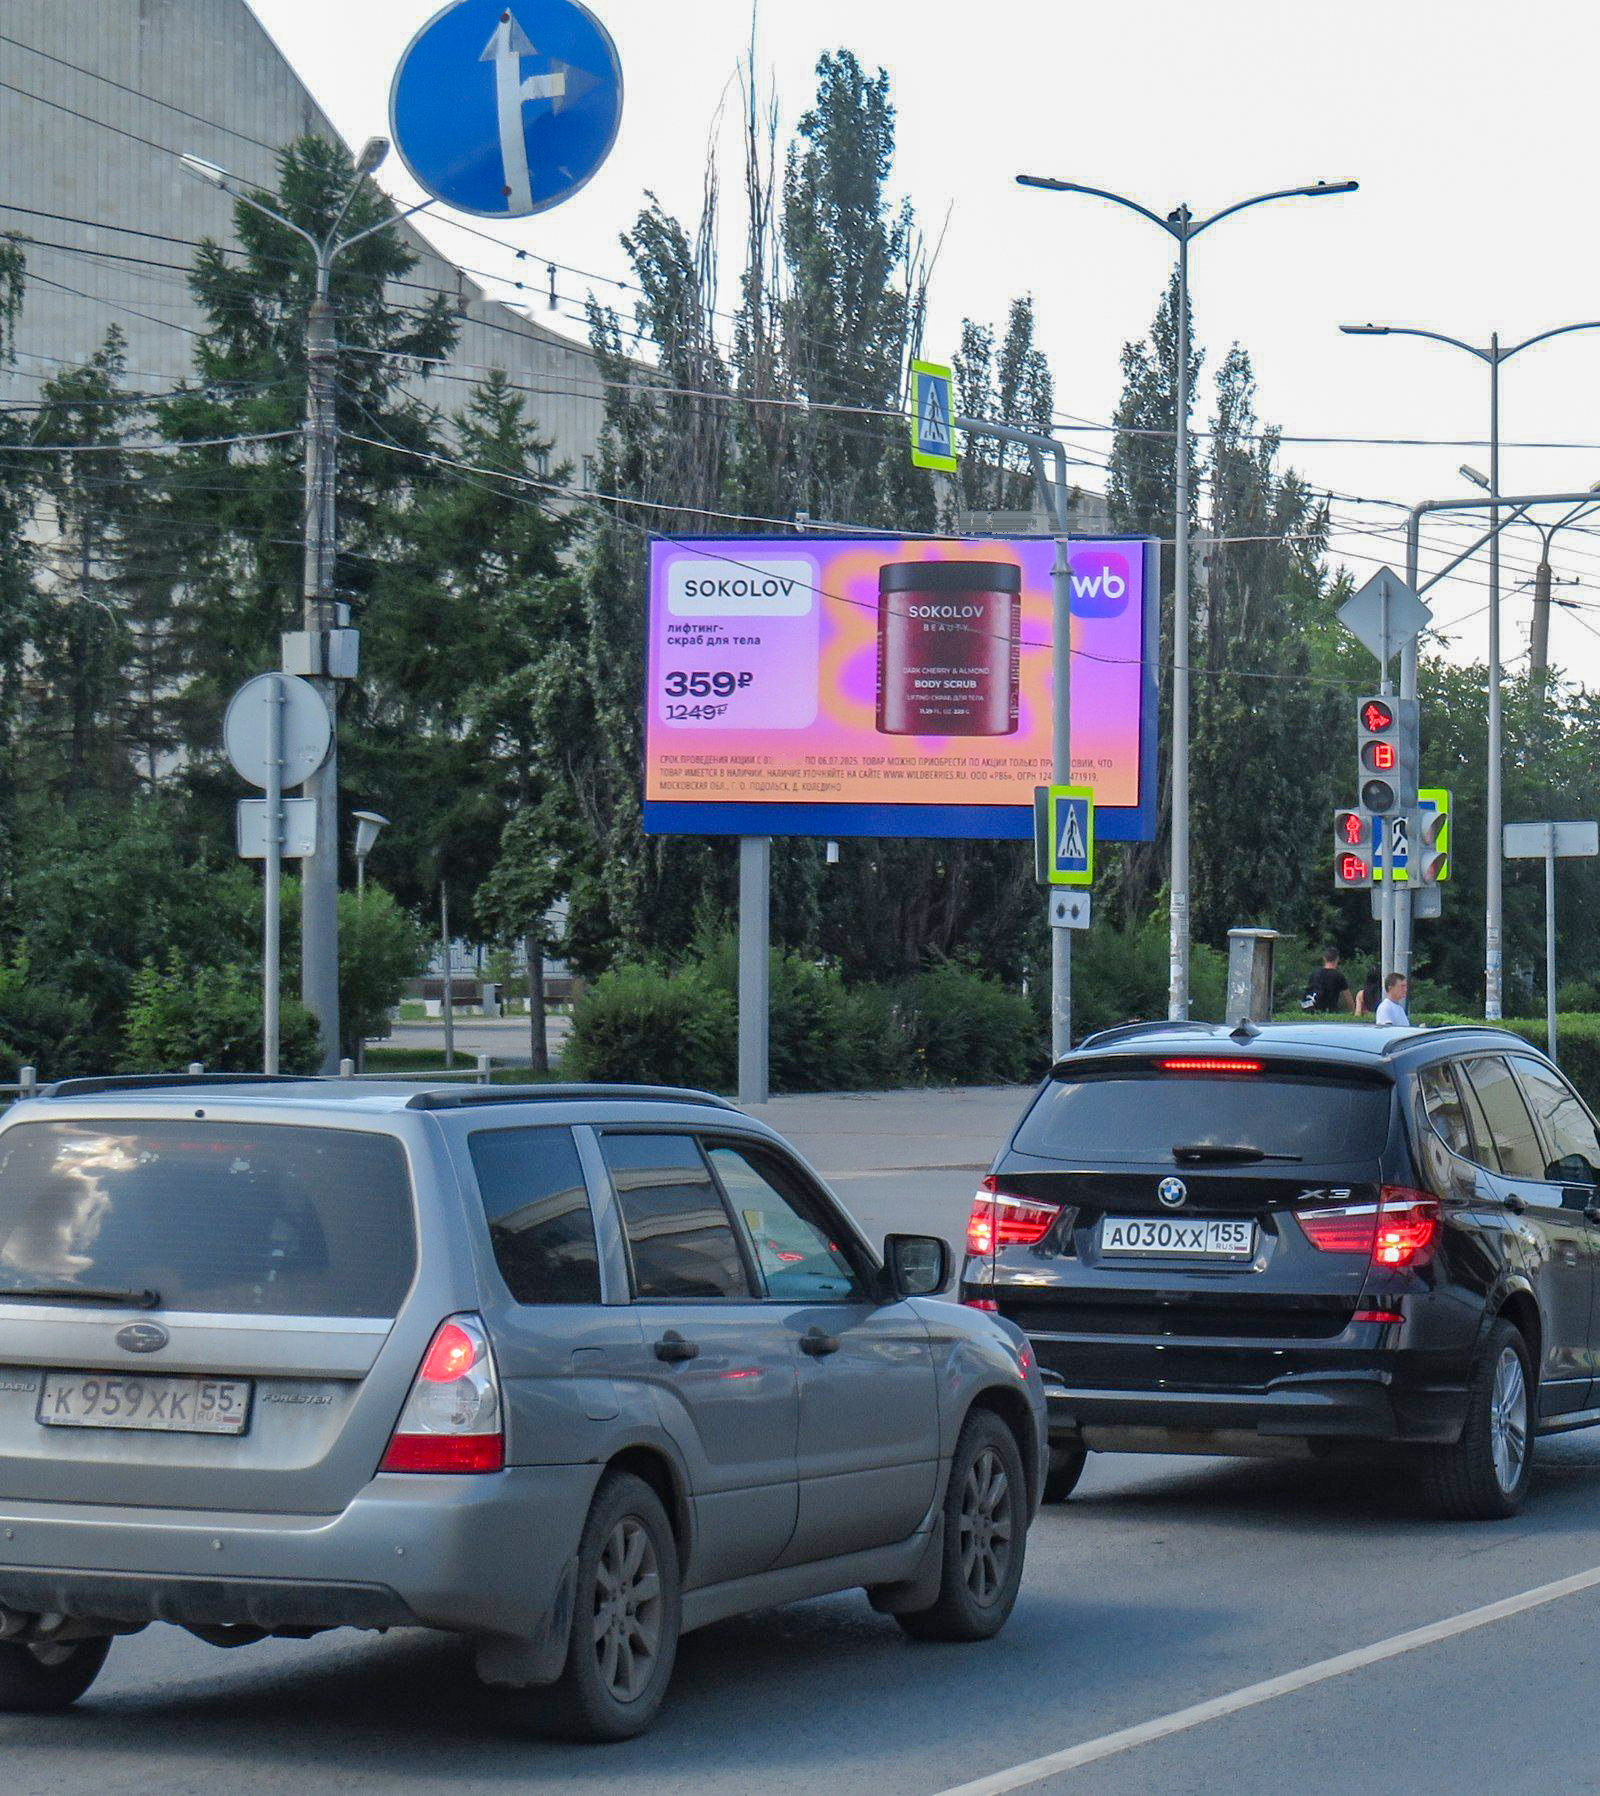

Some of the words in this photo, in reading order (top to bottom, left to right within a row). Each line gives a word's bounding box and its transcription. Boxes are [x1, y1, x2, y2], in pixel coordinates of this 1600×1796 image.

[684, 579, 795, 598] SOKOLOV
[909, 605, 984, 618] SOKOLOV
[667, 623, 724, 635] лифтинг-
[667, 634, 704, 647] скраб
[706, 636, 729, 647] для
[733, 637, 761, 646] тела
[914, 680, 942, 689] BODY
[943, 680, 978, 689] SCRUB
[1343, 857, 1367, 880] 64
[1297, 1188, 1351, 1200] X3
[1110, 1222, 1203, 1248] А030ХХ
[1209, 1222, 1244, 1242] 155
[1215, 1243, 1234, 1251] RUS
[201, 1384, 235, 1411] 55
[262, 1392, 334, 1404] FORESTER
[199, 1410, 222, 1423] RUS
